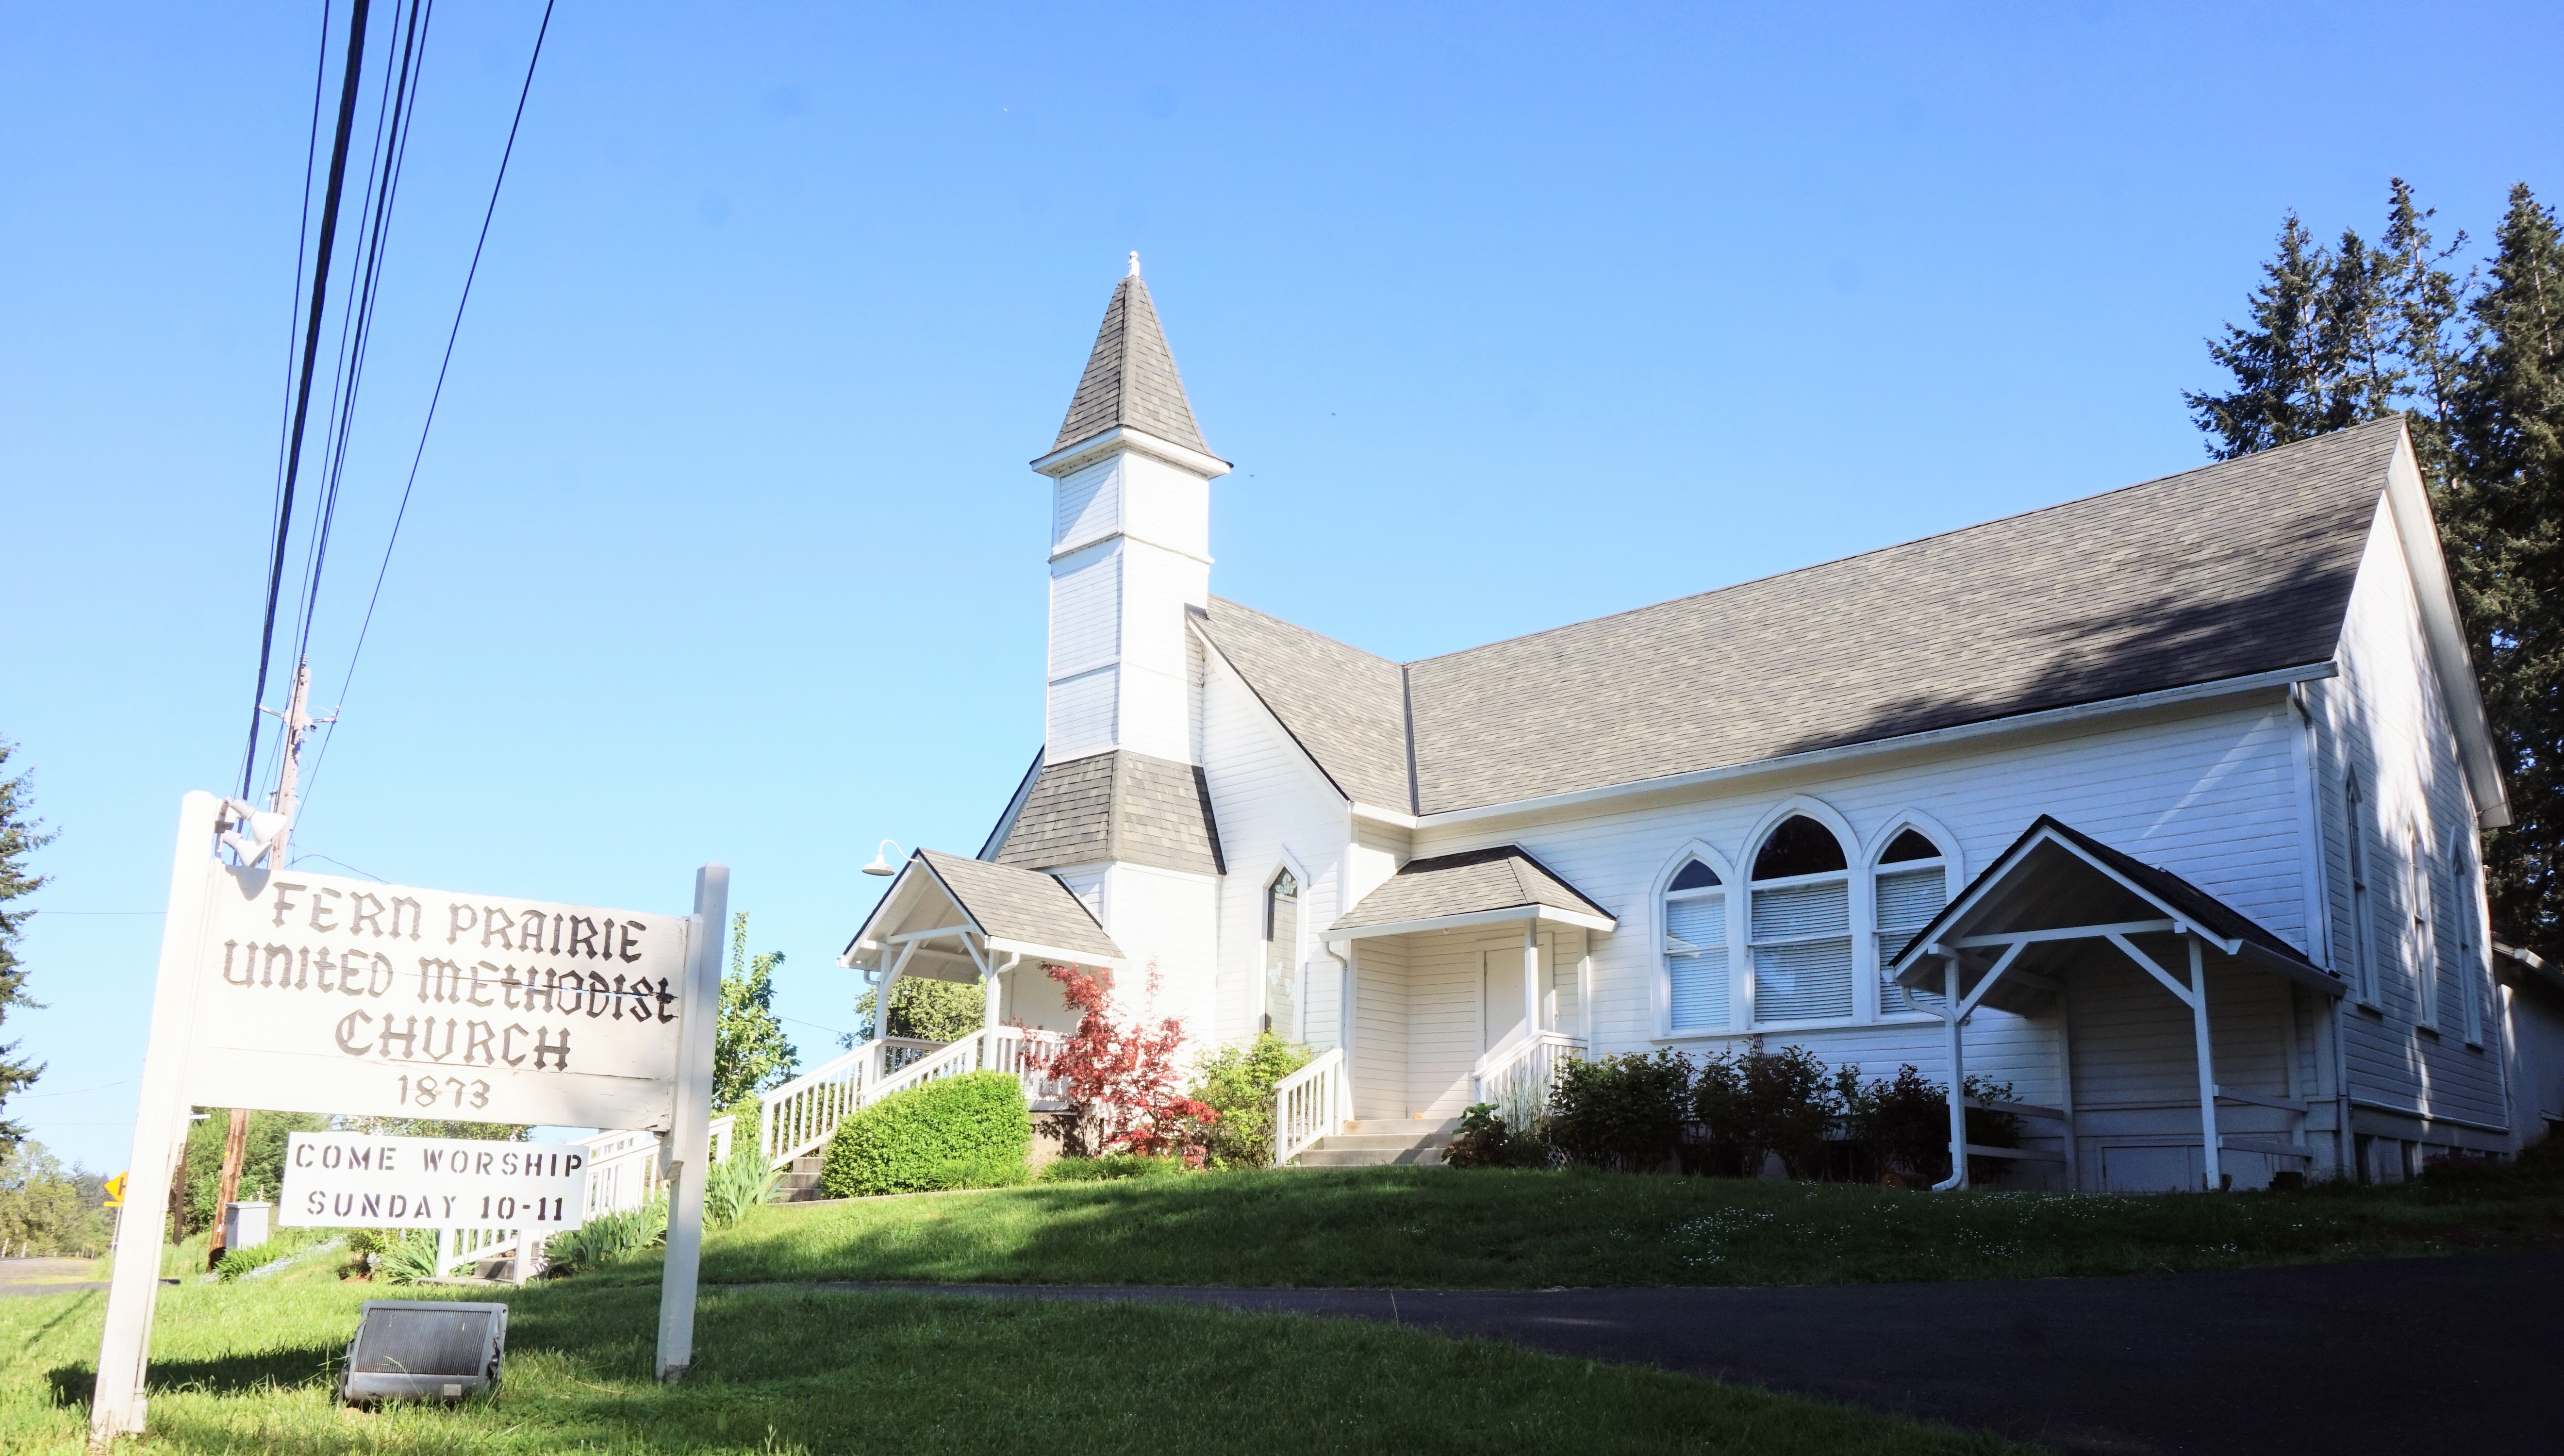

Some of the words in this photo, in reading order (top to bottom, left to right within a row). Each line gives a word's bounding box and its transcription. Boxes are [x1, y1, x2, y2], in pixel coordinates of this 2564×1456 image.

[272, 882, 421, 942] FERN
[447, 903, 646, 963] PRAIRIE
[223, 939, 393, 998] UNITED
[418, 956, 675, 1024] METHODIST
[335, 1009, 571, 1071] CHURCH
[397, 1075, 491, 1109] 1873
[296, 1143, 397, 1171] COME
[423, 1149, 582, 1177] WORSHIP
[307, 1191, 457, 1219] SUNDAY
[480, 1196, 562, 1221] 10-11
